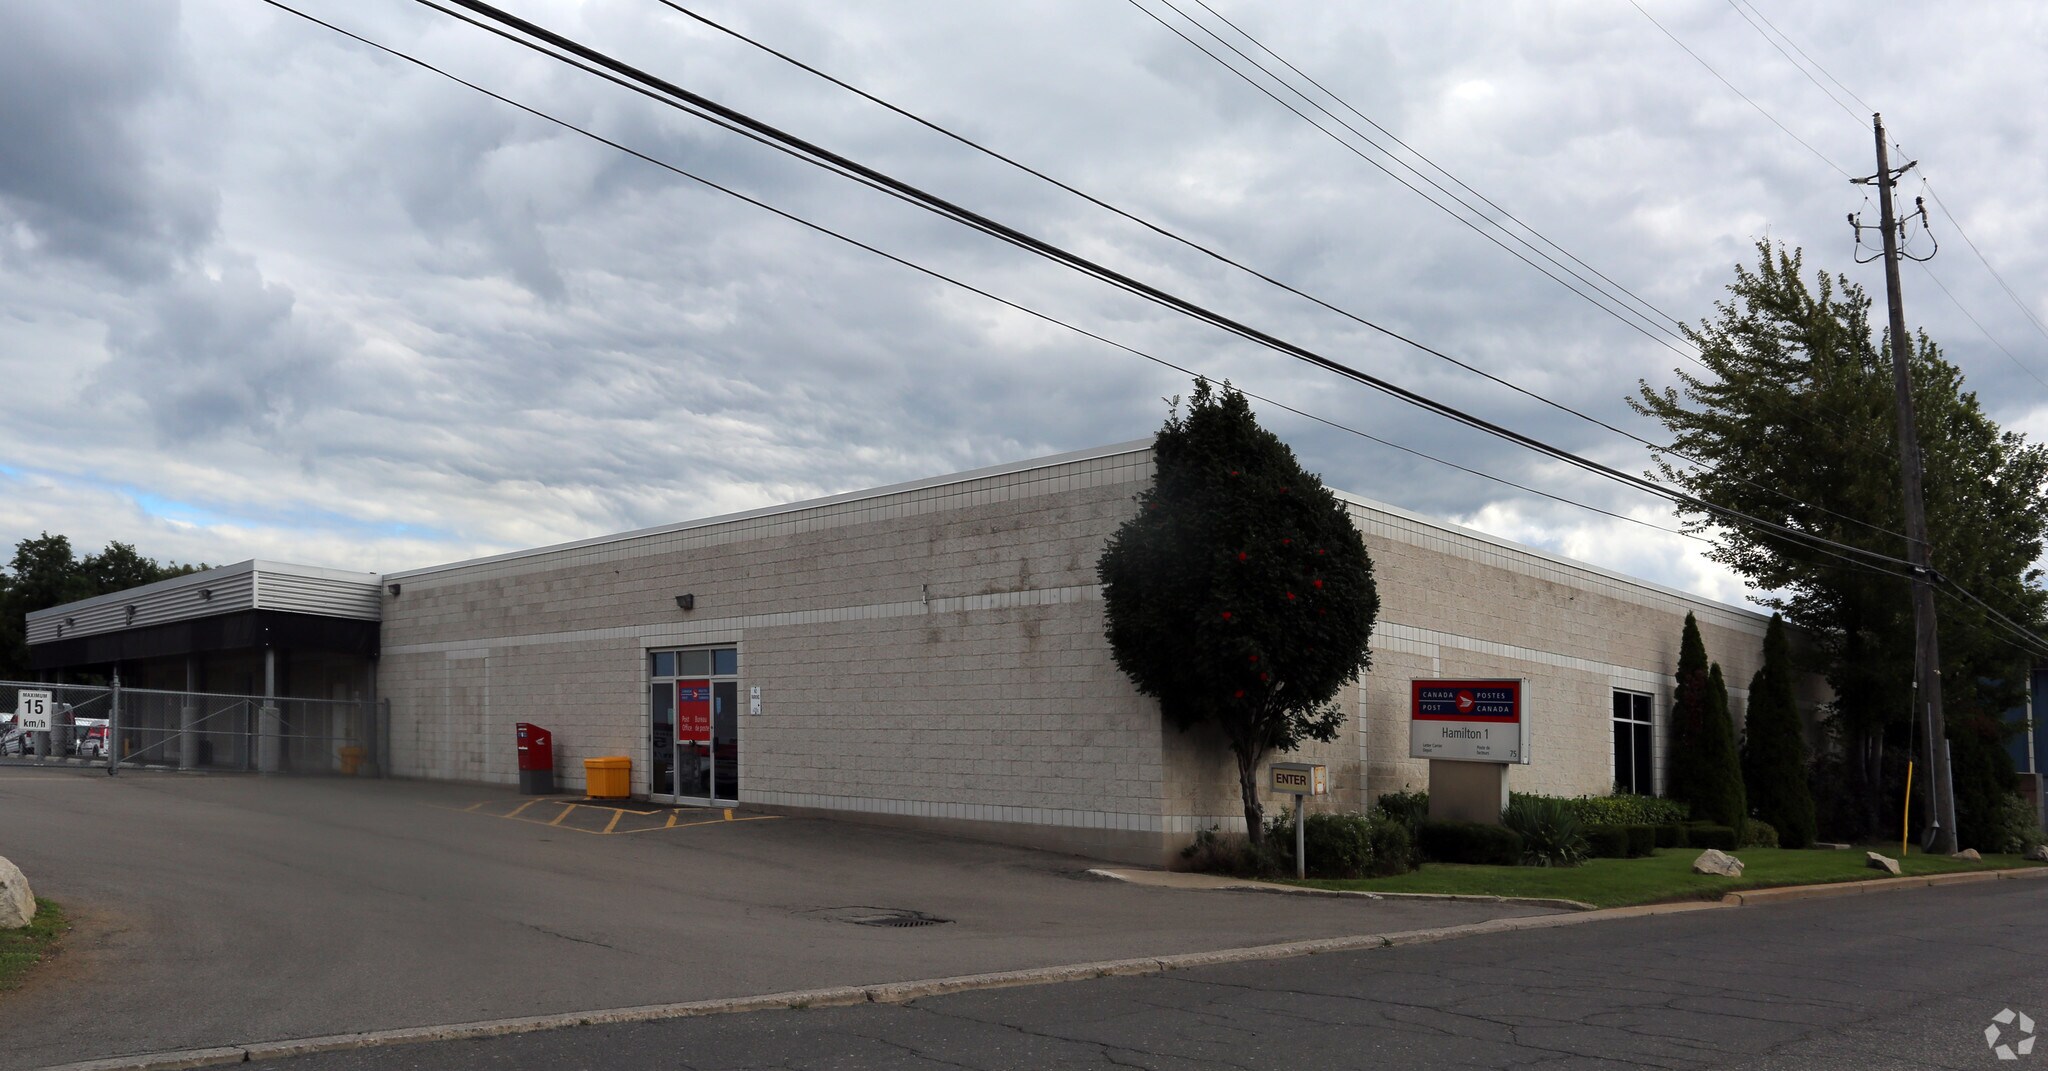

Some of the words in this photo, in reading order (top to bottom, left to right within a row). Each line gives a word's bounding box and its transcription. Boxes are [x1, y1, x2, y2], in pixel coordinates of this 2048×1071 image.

[24, 699, 44, 714] 15
[1476, 705, 1510, 713] CANADA
[23, 719, 46, 728] km/h
[1442, 727, 1482, 740] Hamilton
[1484, 728, 1489, 740] 1
[1510, 750, 1517, 758] 75
[1276, 773, 1307, 786] ENTER
